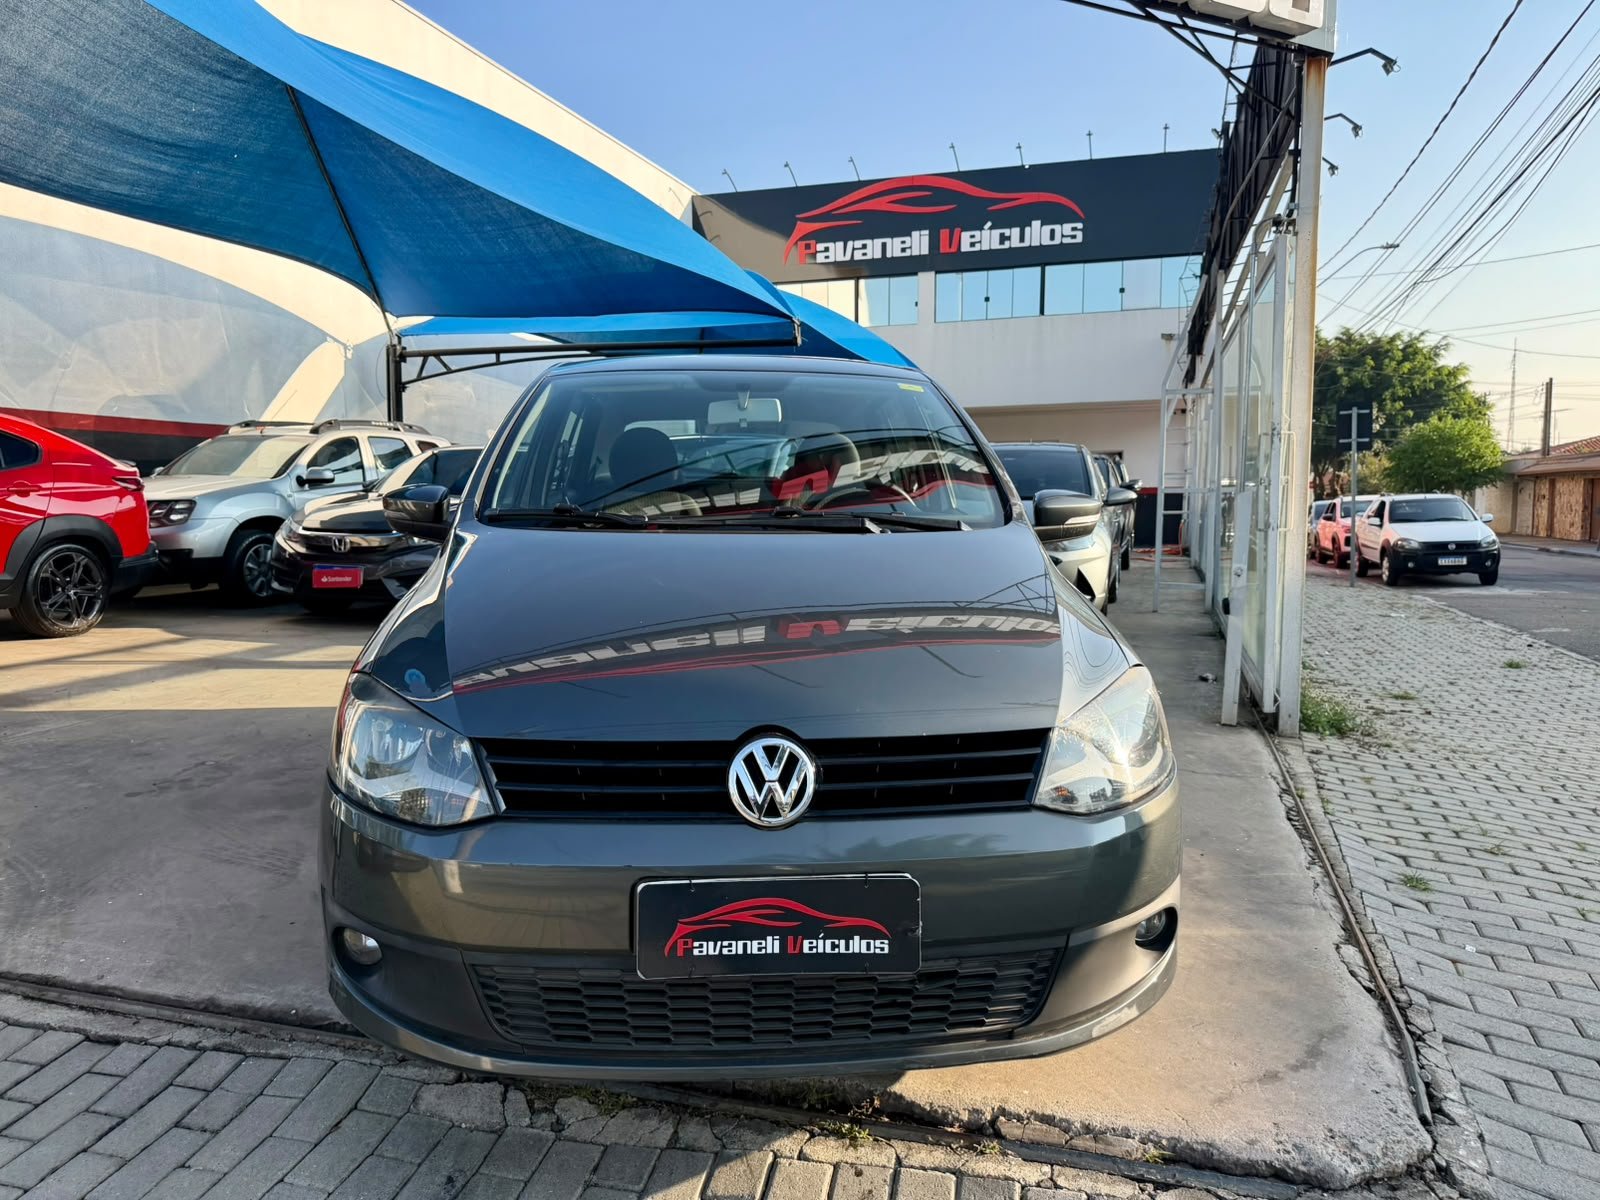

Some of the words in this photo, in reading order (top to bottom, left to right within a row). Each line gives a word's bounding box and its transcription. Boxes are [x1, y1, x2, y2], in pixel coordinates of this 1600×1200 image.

[798, 229, 930, 265] Pavaneli
[939, 219, 1084, 255] Veículos
[732, 741, 811, 822] VW
[676, 935, 780, 957] Pavaneli
[787, 932, 890, 955] Veículos
